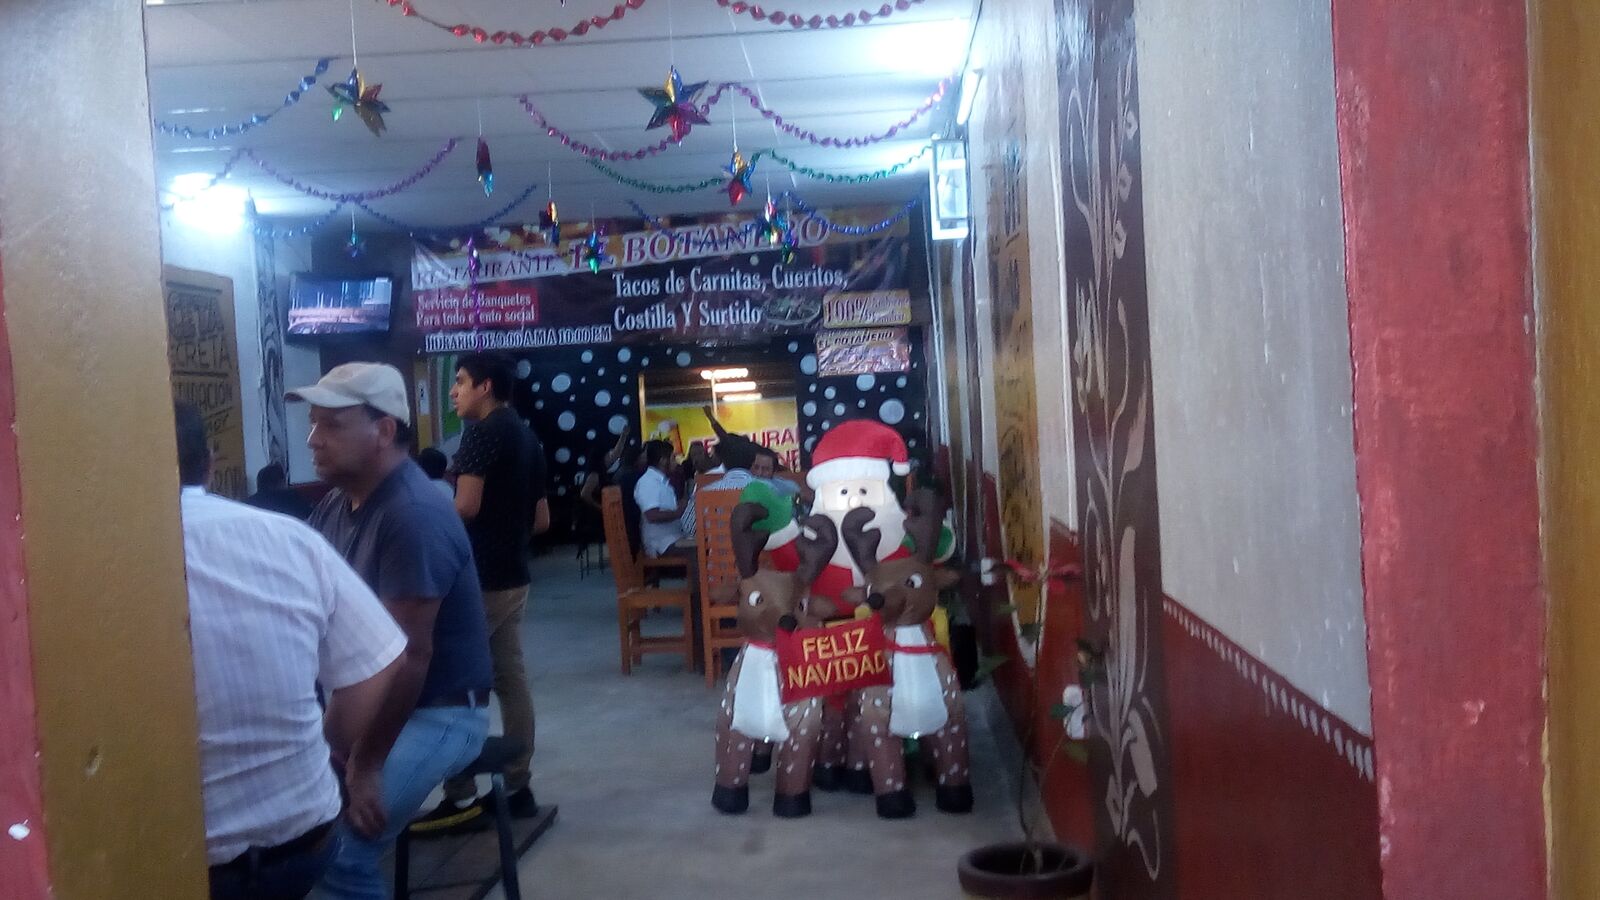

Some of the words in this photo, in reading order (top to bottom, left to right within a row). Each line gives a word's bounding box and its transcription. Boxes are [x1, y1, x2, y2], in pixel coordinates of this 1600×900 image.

[612, 272, 660, 297] Tacos
[665, 269, 685, 293] de
[690, 264, 766, 293] Carnitas,
[772, 263, 849, 290] Cueritos,
[418, 293, 459, 310] Servicio
[462, 293, 474, 308] de
[477, 292, 531, 309] Banquetes
[826, 297, 869, 323] 100%
[416, 310, 440, 327] Para
[442, 308, 466, 325] todo
[469, 309, 502, 324] eento
[505, 304, 535, 322] social
[614, 302, 676, 331] Costilla
[682, 302, 693, 327] Y
[700, 301, 762, 326] Surtido
[425, 331, 478, 352] HORARIO
[802, 628, 869, 662] FELIZ
[788, 650, 885, 690] NAVIDAD
